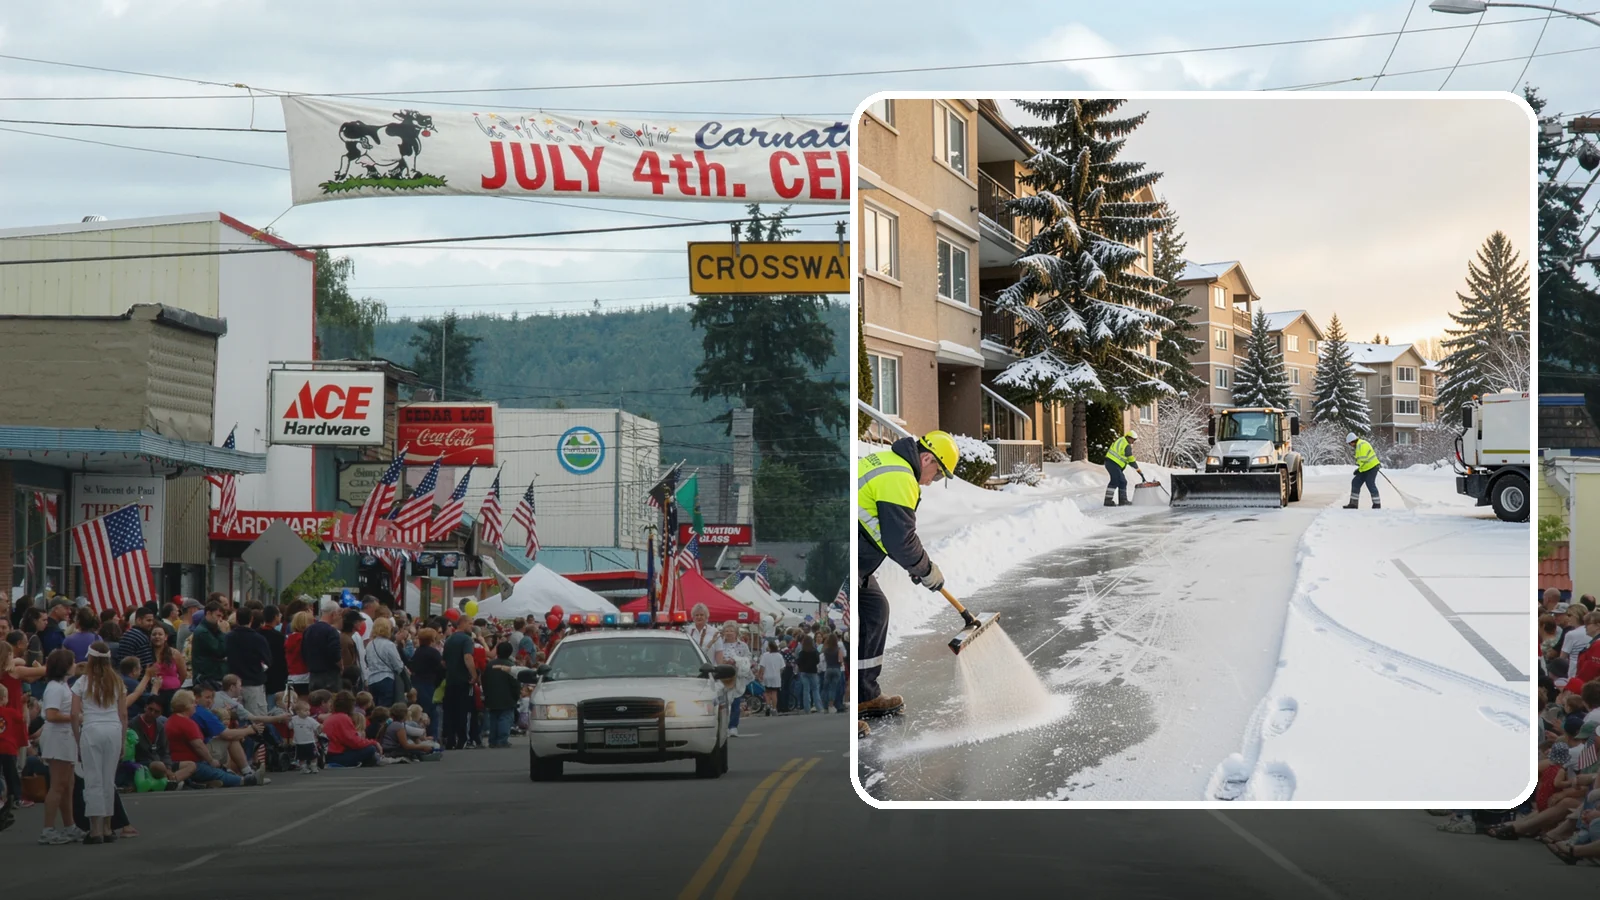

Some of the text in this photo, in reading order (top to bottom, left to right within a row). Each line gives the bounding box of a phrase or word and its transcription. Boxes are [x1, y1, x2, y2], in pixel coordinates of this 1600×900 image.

[481, 141, 605, 192] JULY
[632, 150, 746, 198] 4th.
[697, 254, 850, 280] CROSSWA
[282, 380, 373, 420] ACE
[406, 409, 485, 422] CEDAR LOG
[283, 421, 371, 437] Hardware
[96, 484, 124, 494] Vincent
[126, 486, 136, 494] de
[137, 486, 155, 495] Paul
[688, 526, 742, 535] CRNATION
